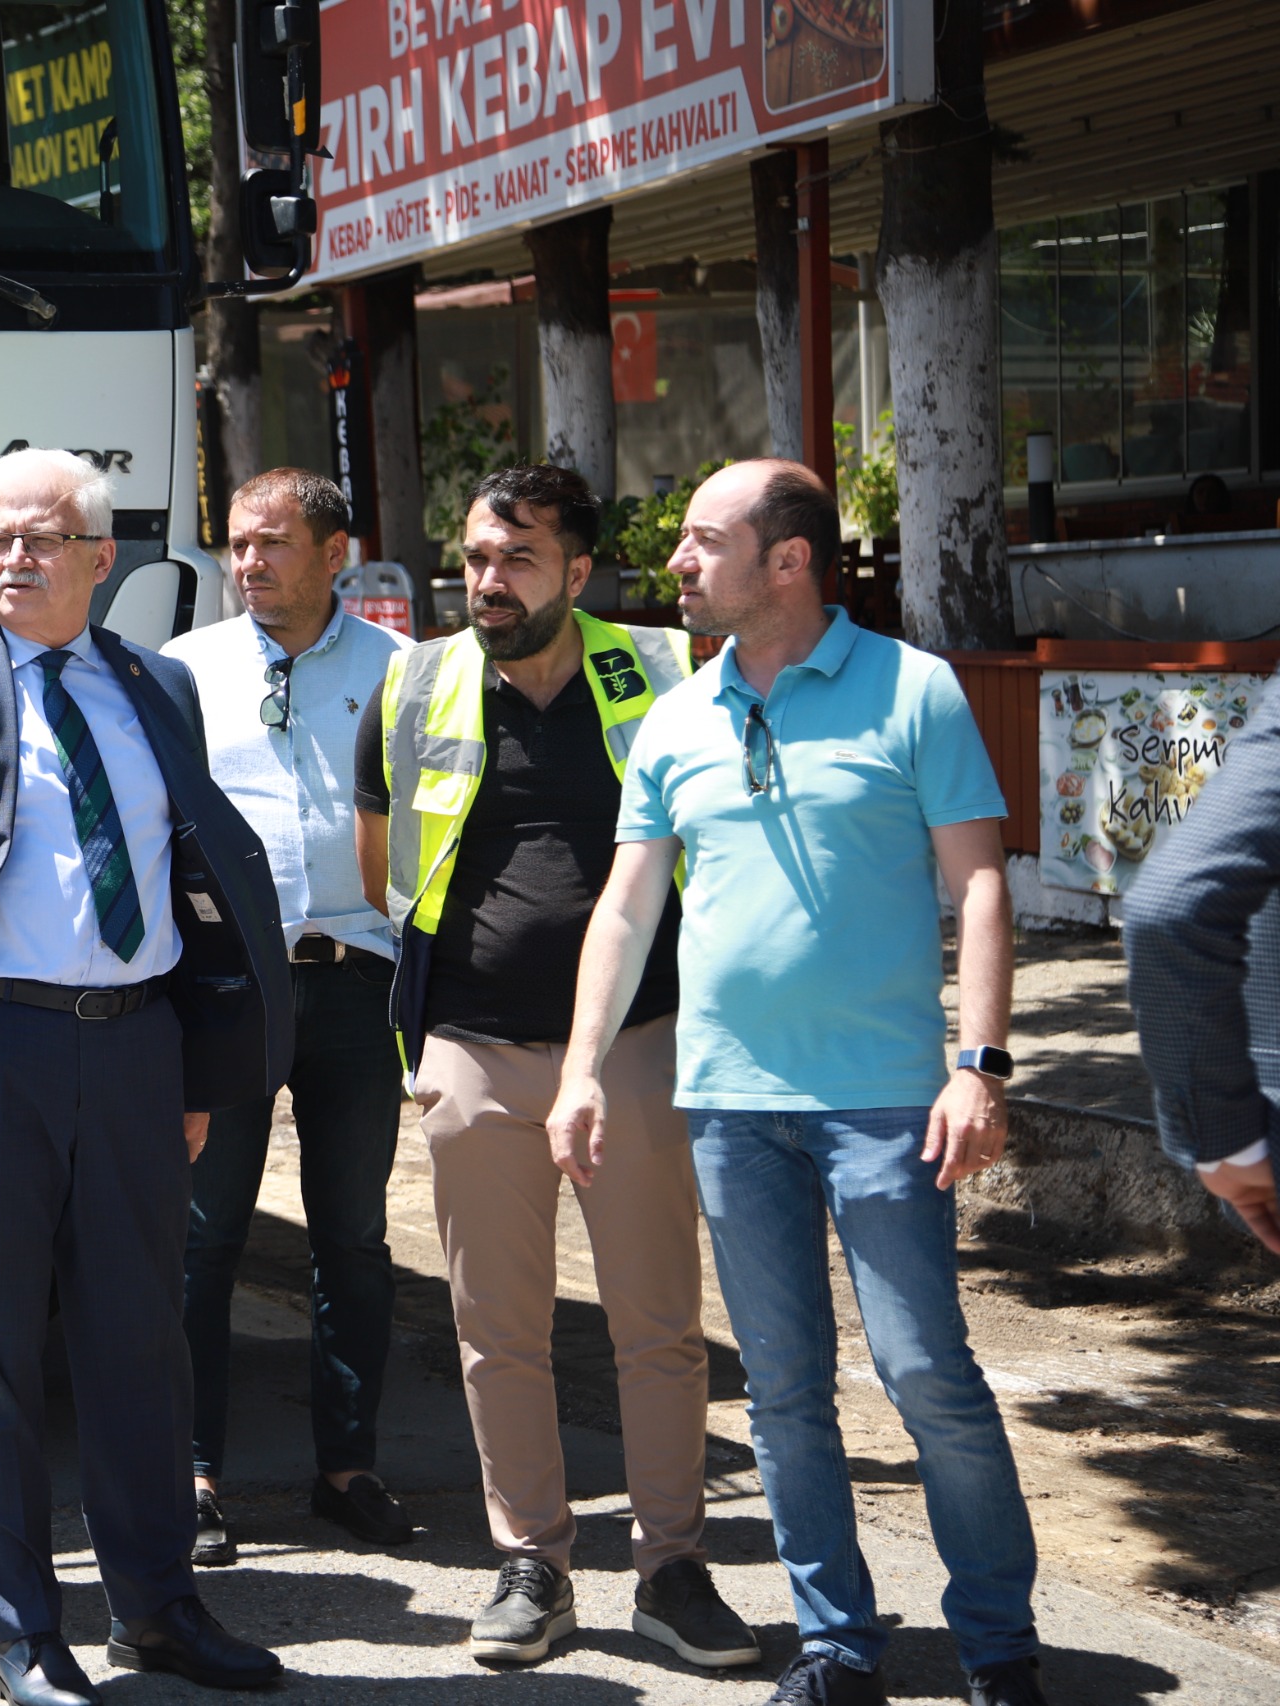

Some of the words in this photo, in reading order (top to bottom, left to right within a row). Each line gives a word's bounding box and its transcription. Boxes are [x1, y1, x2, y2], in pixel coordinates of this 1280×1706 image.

[49, 40, 112, 114] KAMP
[320, 68, 426, 197] ZIRH
[438, 0, 622, 156] KEBAP
[328, 217, 374, 260] KEBAP
[386, 198, 431, 244] KÖFTE
[445, 179, 480, 225] PİDE
[494, 157, 550, 211] KANAT
[565, 126, 638, 187] SERPME
[641, 91, 738, 162] KAHVALTI
